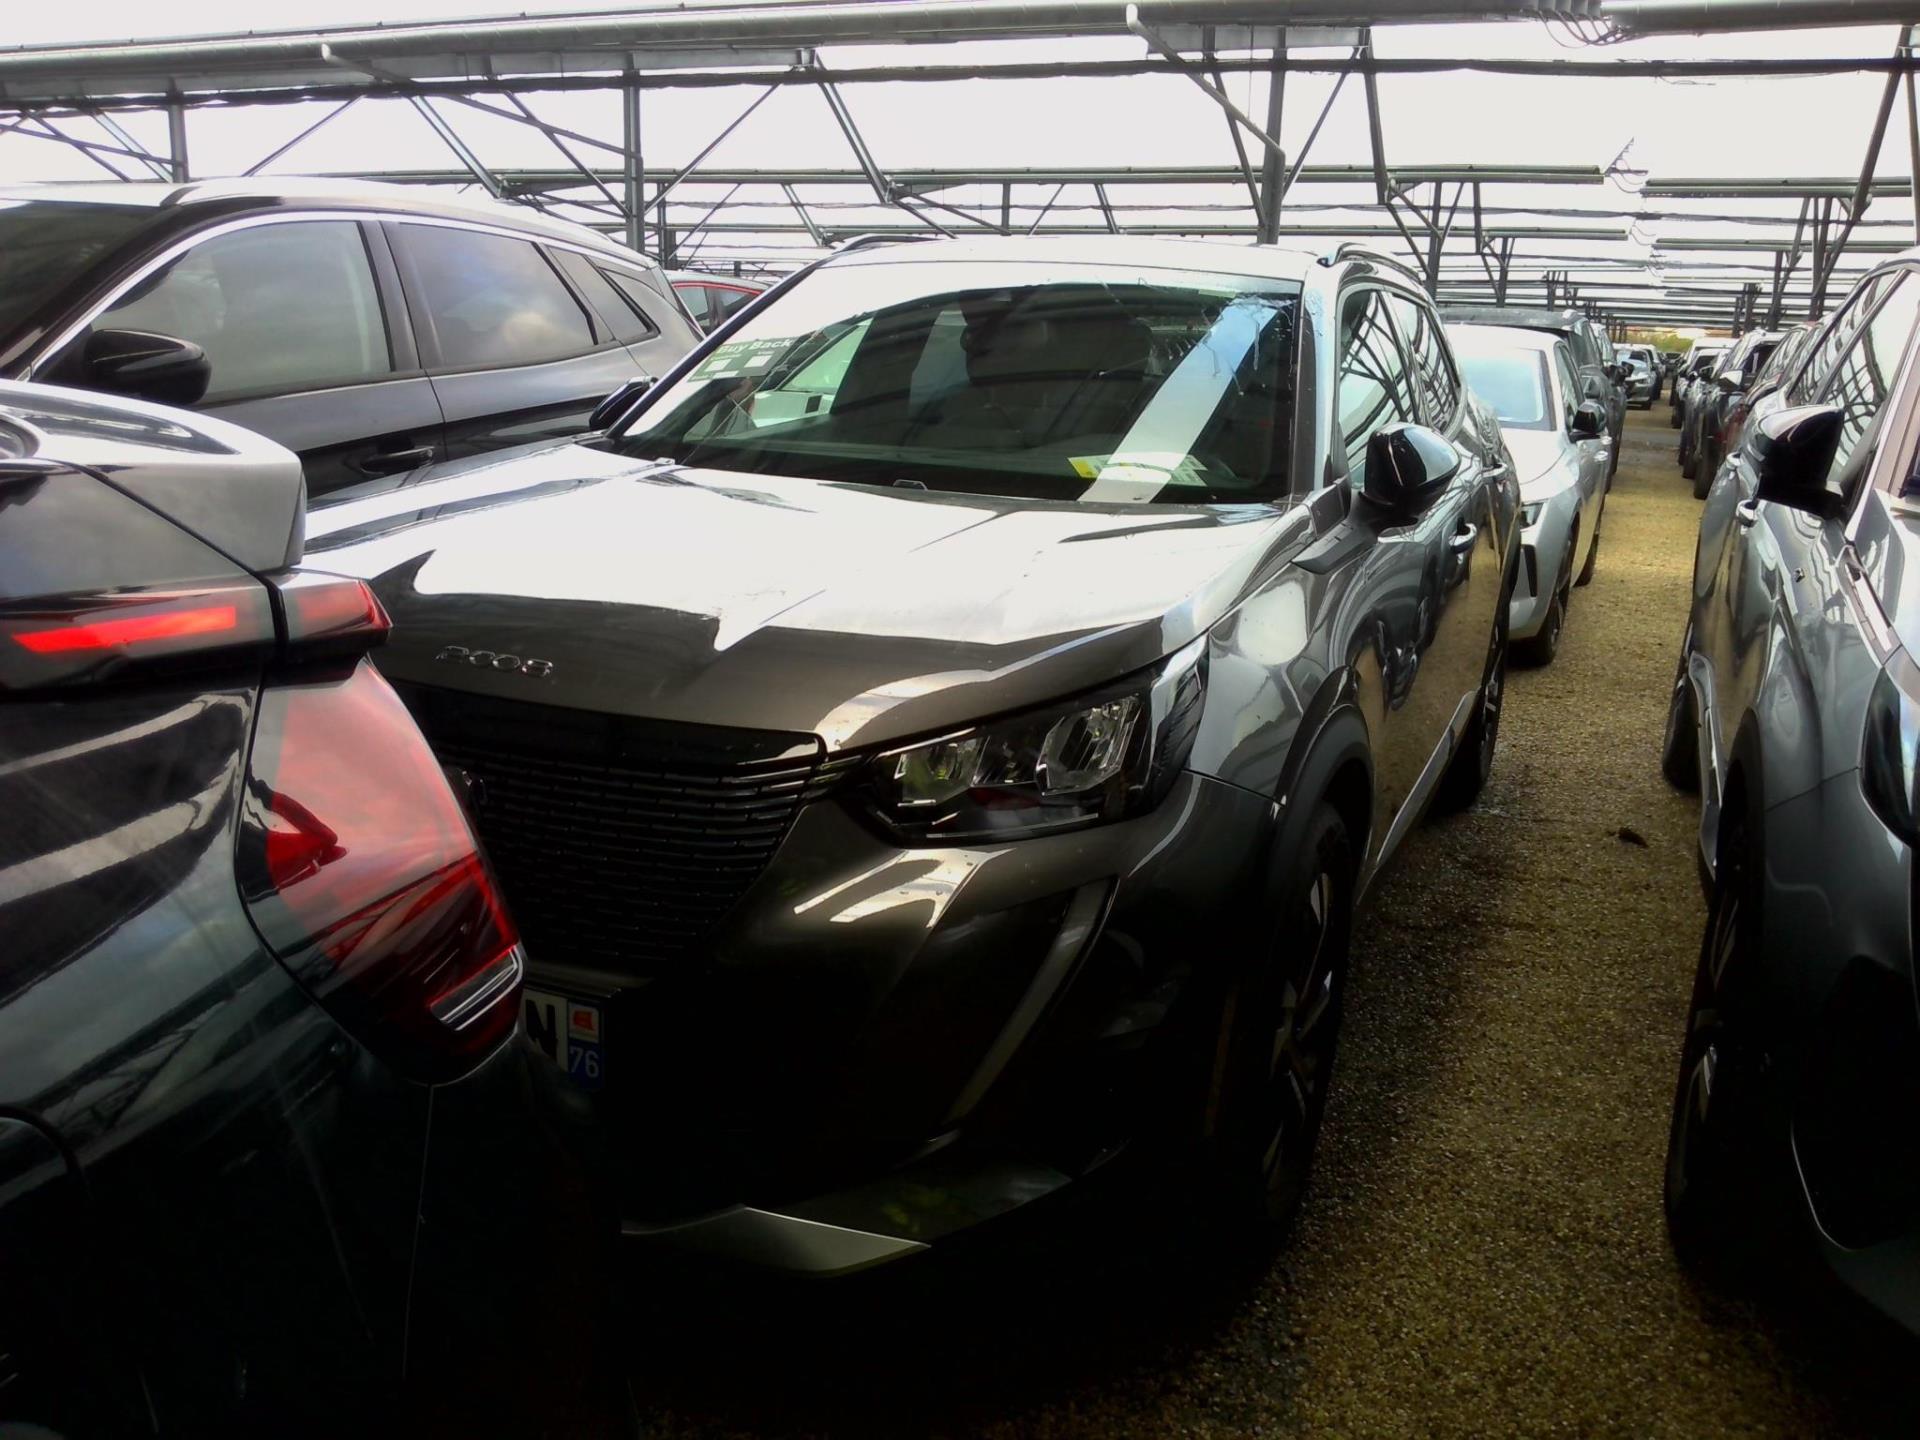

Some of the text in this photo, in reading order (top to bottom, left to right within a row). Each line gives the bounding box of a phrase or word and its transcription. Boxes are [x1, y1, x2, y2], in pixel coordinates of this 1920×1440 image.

[716, 345, 748, 354] Buy
[748, 338, 794, 350] Back
[435, 645, 554, 678] 2008
[568, 1045, 599, 1078] 76
